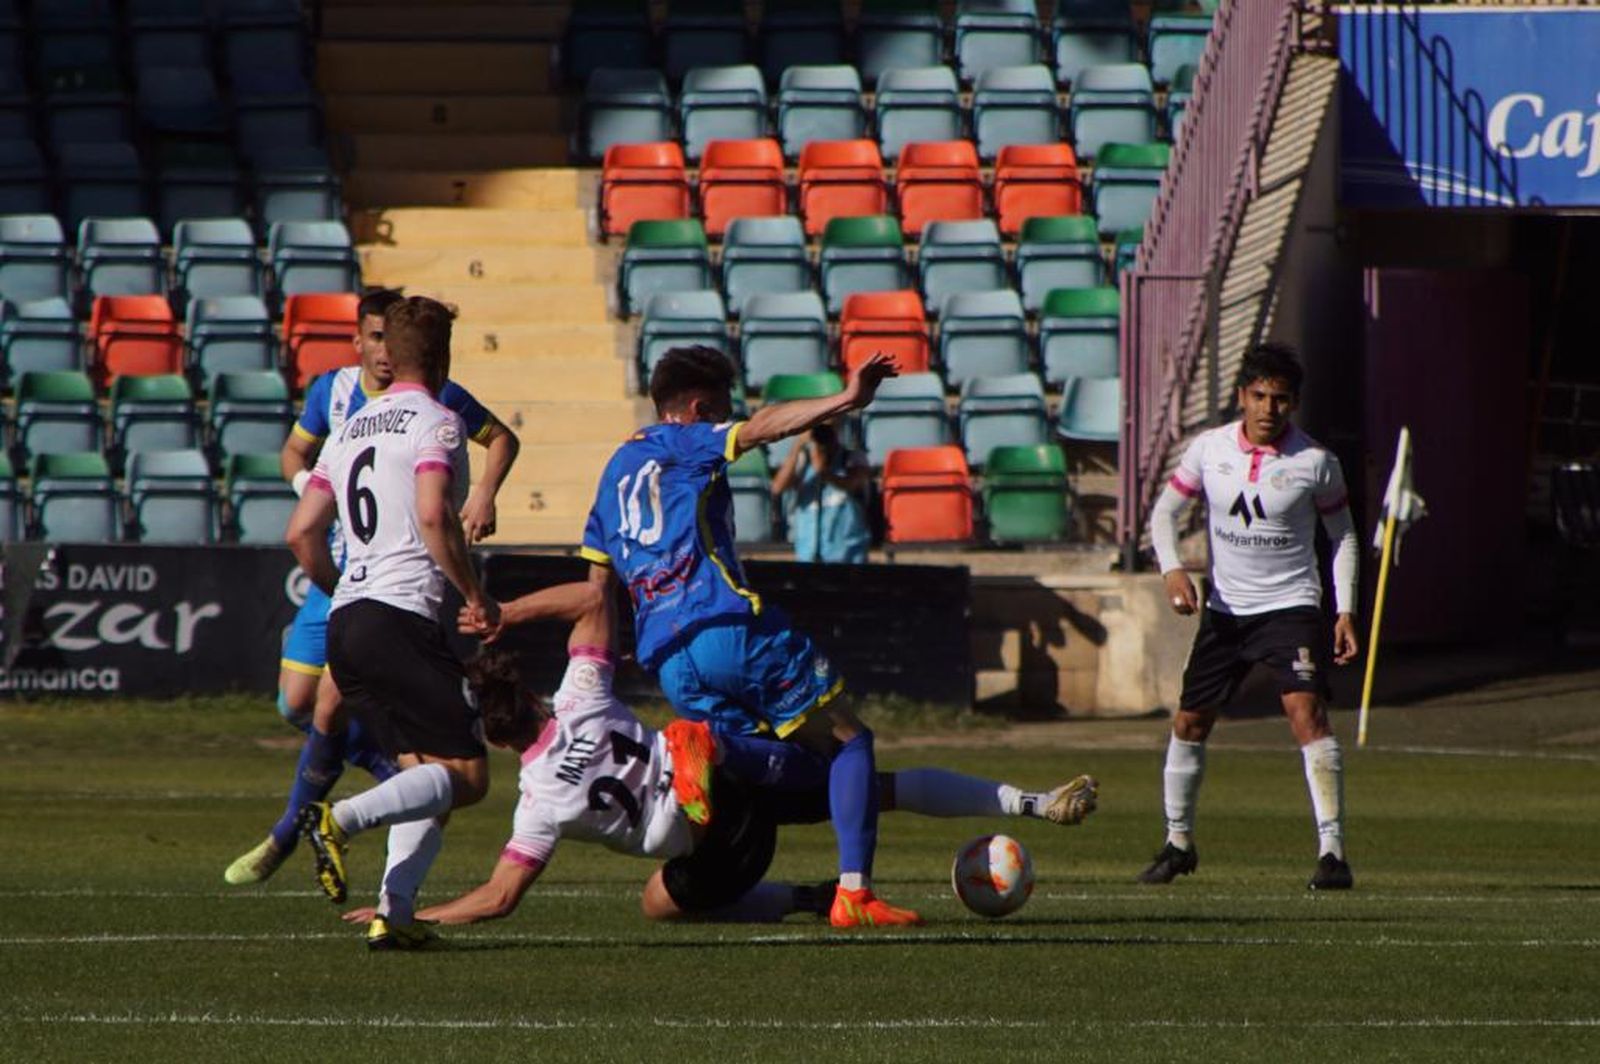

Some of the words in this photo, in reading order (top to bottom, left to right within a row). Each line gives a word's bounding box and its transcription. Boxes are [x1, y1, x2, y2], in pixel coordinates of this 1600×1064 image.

[453, 180, 467, 200] 7
[469, 260, 484, 278] 6
[347, 446, 377, 545] 6
[617, 459, 663, 546] 10
[67, 564, 158, 592] DAVID
[44, 600, 222, 655] zar
[588, 730, 651, 829] 21
